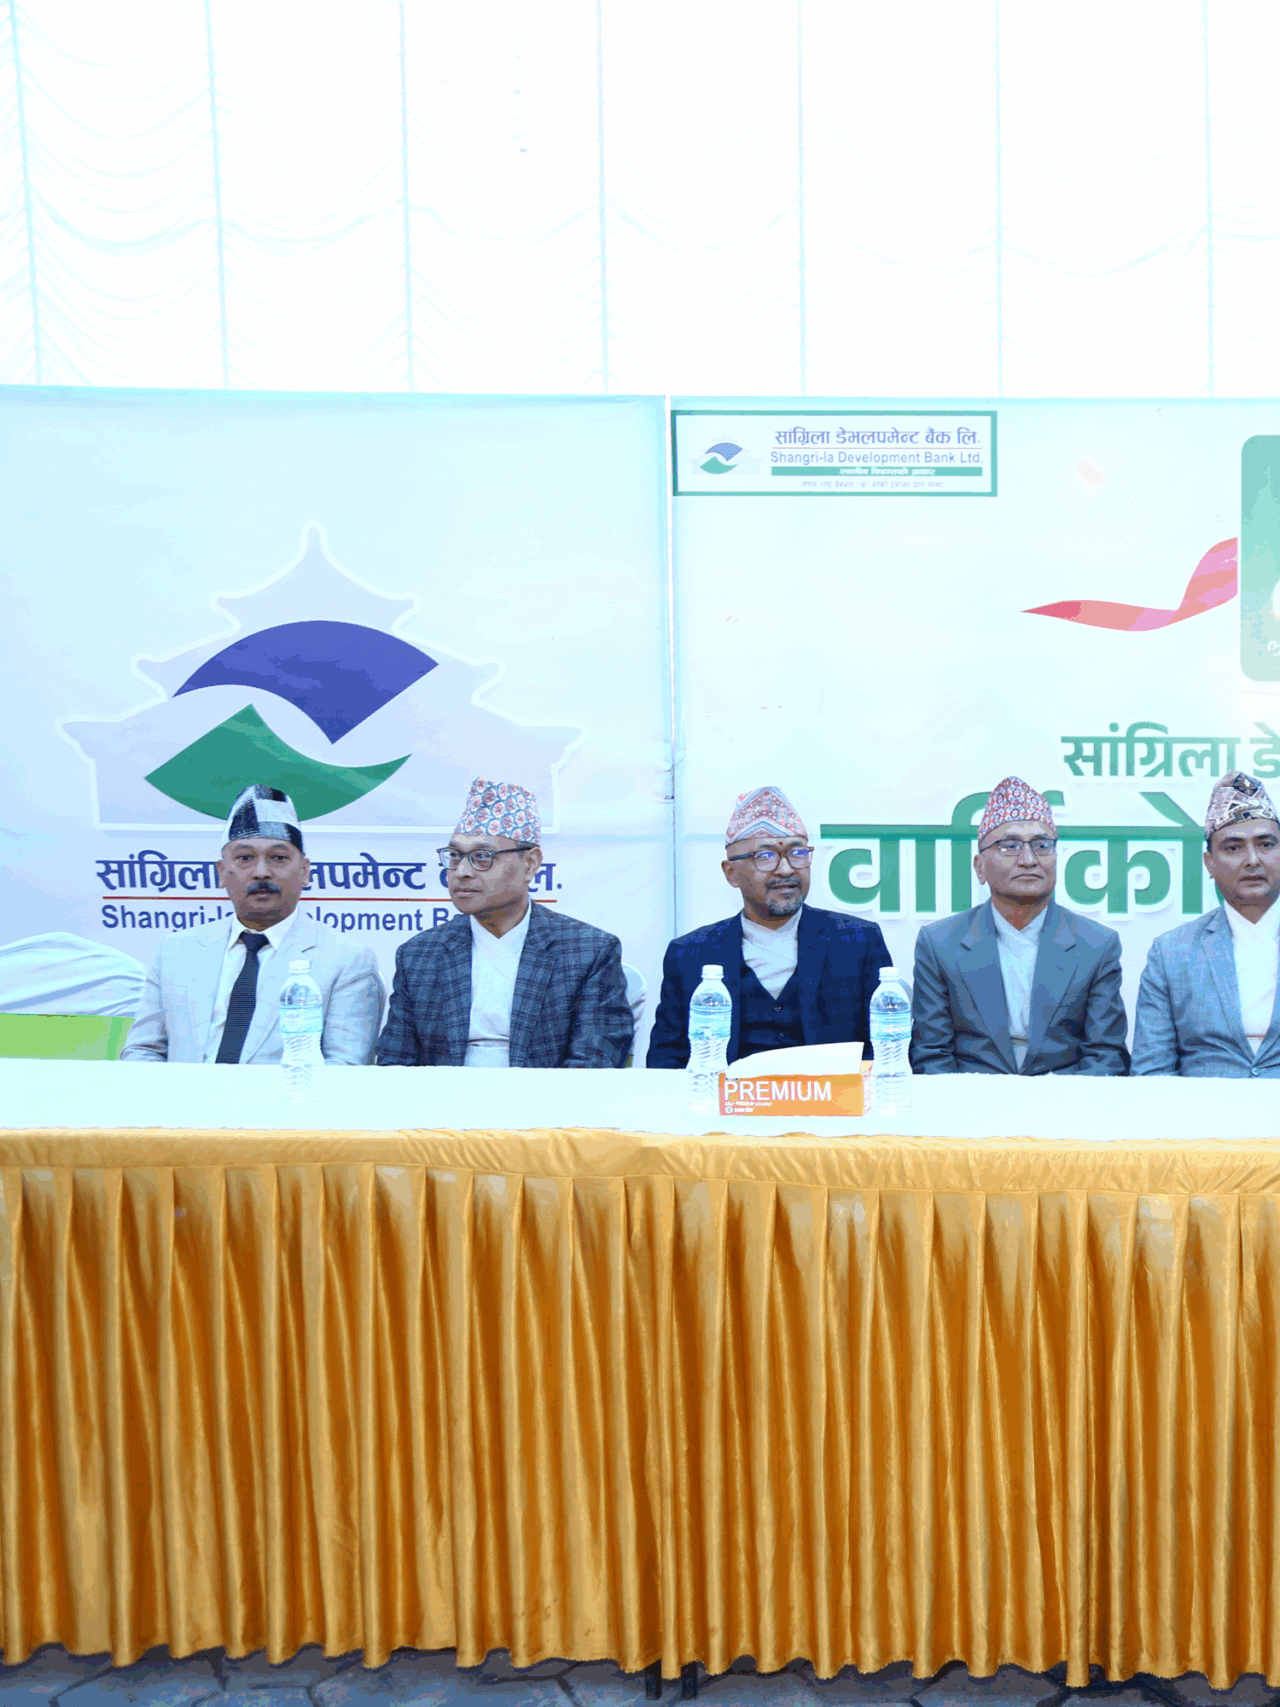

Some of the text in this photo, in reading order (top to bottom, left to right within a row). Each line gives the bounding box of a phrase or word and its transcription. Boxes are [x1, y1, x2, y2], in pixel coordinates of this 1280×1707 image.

[774, 426, 981, 446] सांग्रिला डेभलपमेन्ट बैंक लि.
[770, 451, 984, 466] Shangri-la Development Bank Ltd.
[1061, 721, 1242, 778] सांग्रिला
[724, 1080, 831, 1101] PREMIUM
